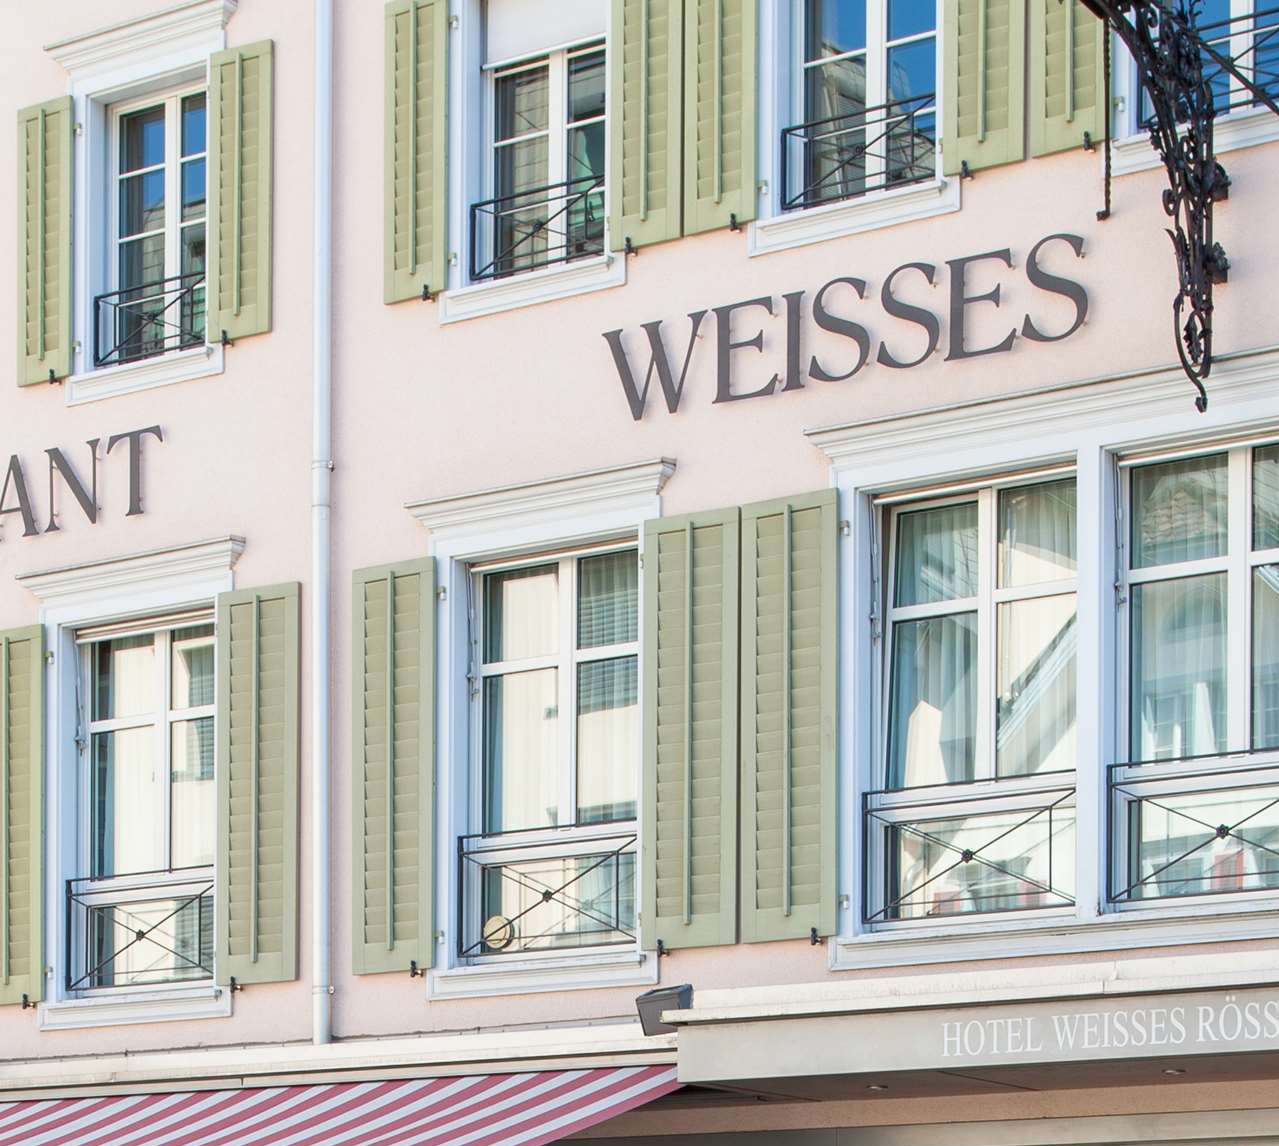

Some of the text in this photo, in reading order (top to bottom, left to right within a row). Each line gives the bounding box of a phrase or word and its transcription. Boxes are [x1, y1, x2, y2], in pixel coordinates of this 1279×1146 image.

[602, 233, 1089, 421] WEISSES
[941, 1017, 1042, 1057] HOTEL
[1052, 1007, 1187, 1050] WEISSES
